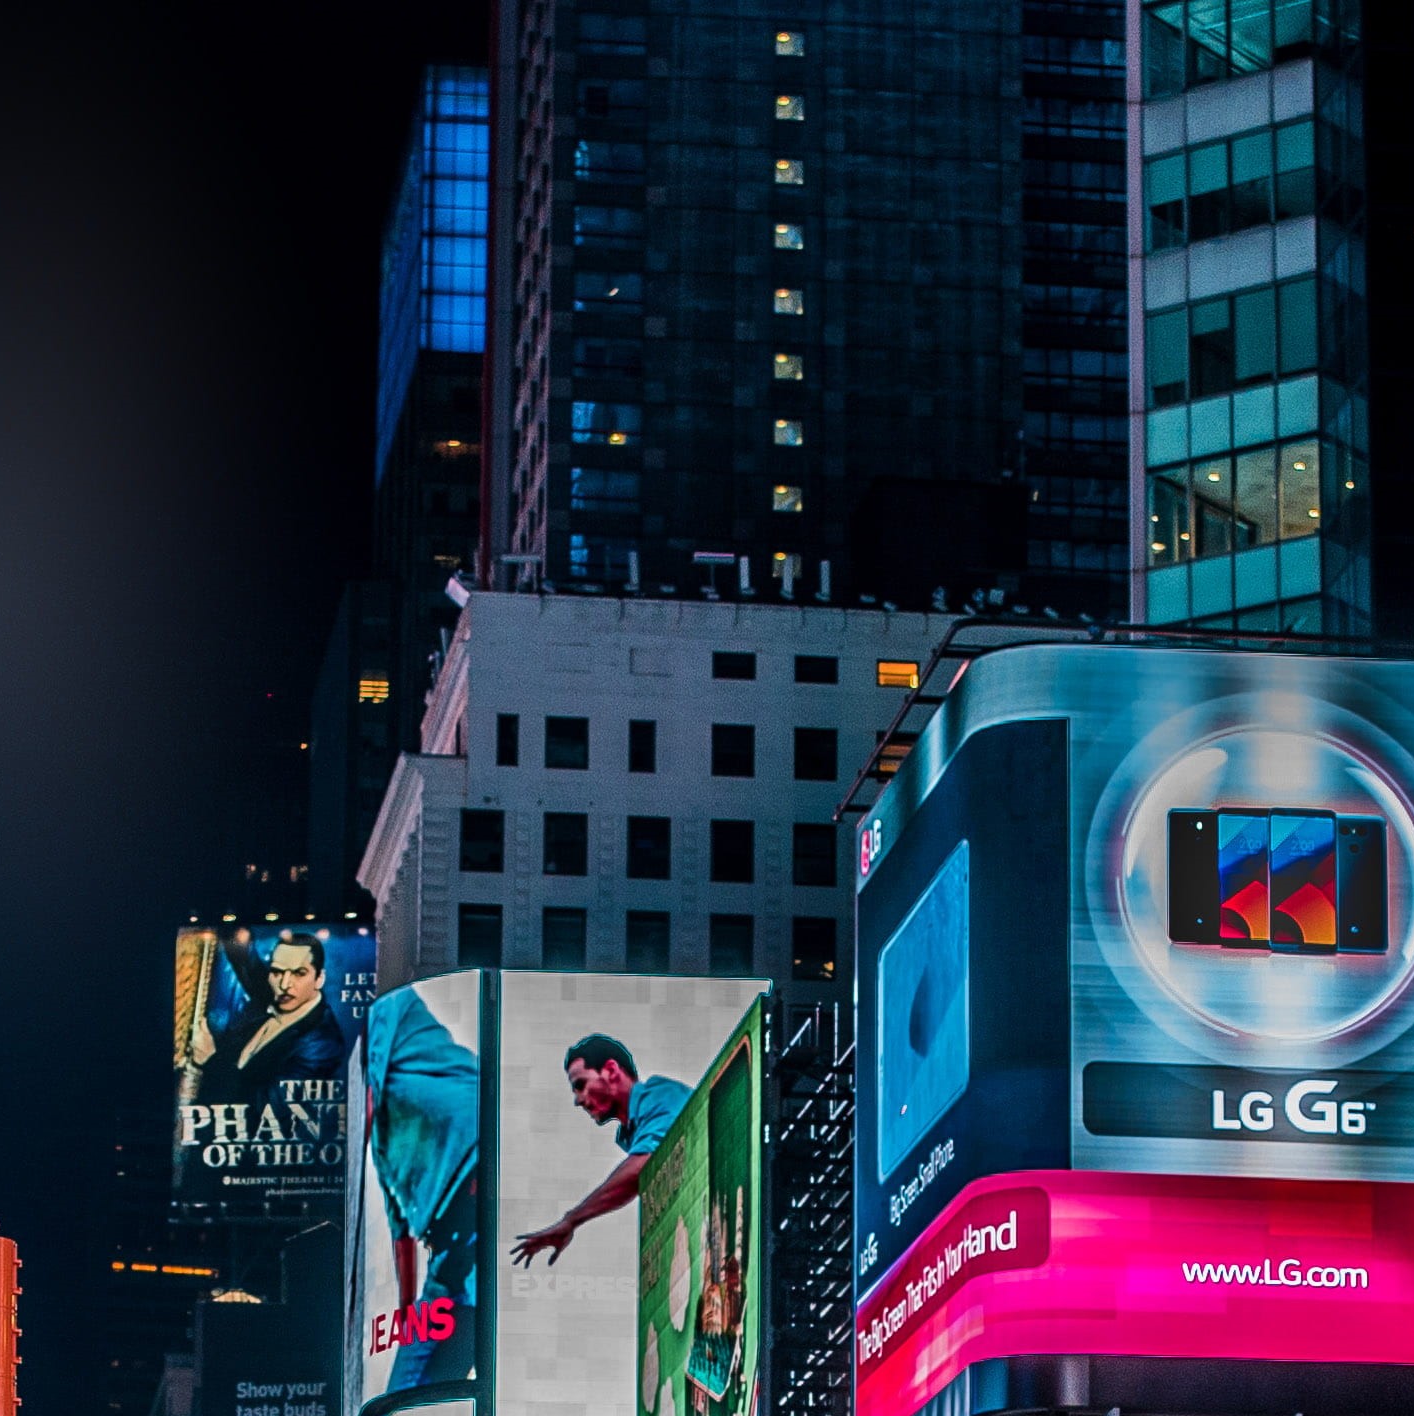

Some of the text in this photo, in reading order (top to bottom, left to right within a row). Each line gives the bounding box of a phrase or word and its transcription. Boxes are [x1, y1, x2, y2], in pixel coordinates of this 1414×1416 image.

[279, 1080, 345, 1102] THE
[1211, 1088, 1275, 1133] LG
[203, 1144, 245, 1168] OF
[250, 1144, 315, 1166] THE
[882, 1300, 907, 1342] Screen
[944, 1243, 963, 1280] Your
[963, 1210, 1017, 1263] Hand
[1181, 1257, 1370, 1290] www.LG.com
[370, 1297, 455, 1357] JEANS
[236, 1382, 327, 1401] Show your
